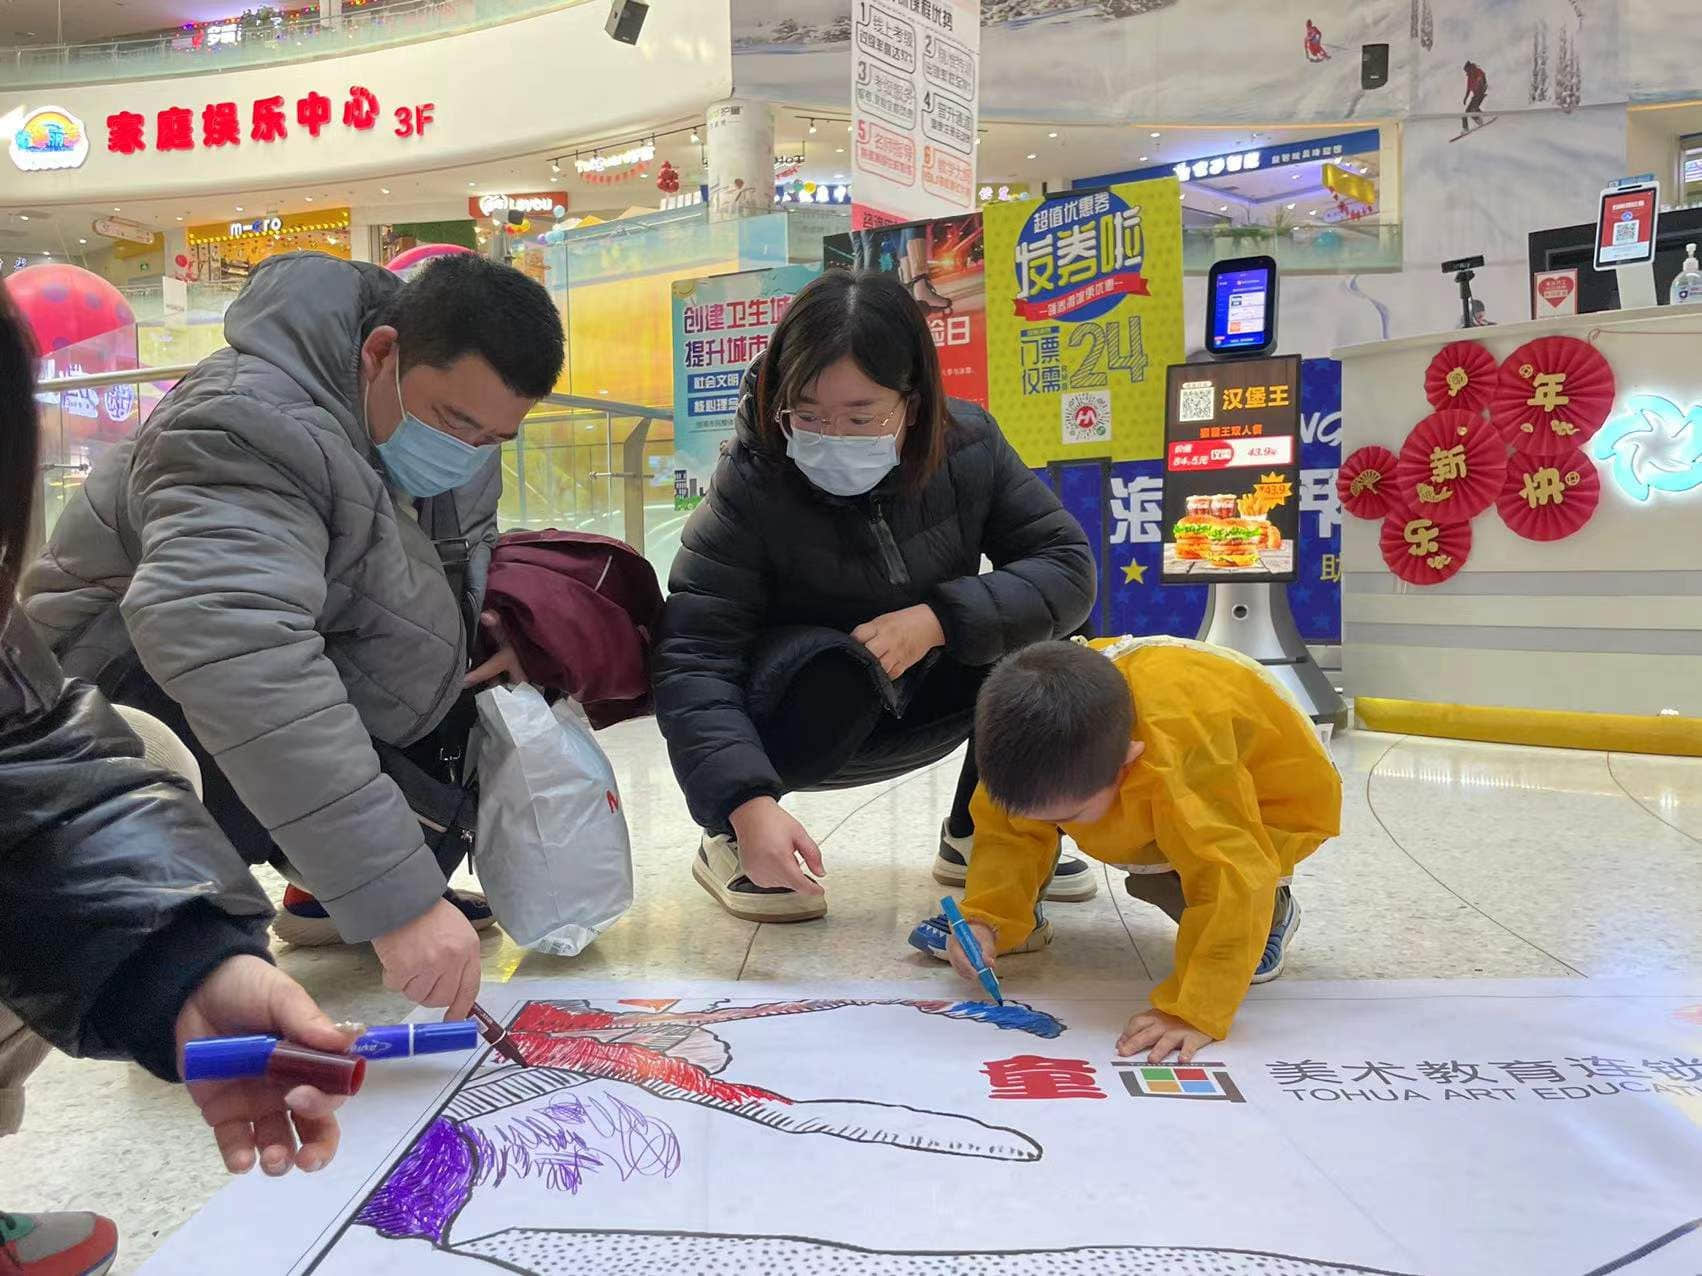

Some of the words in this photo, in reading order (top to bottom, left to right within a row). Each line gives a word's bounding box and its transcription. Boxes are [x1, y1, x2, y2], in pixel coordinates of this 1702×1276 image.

[858, 61, 866, 80] 3
[923, 91, 932, 110] 4
[106, 86, 381, 155] 家庭娱乐中心
[394, 103, 435, 138] 3F
[1034, 191, 1110, 234] 超值优惠券
[684, 295, 793, 334] 创建卫生城
[685, 334, 769, 368] 提升城市
[1020, 336, 1060, 367] 门票
[1067, 315, 1149, 389] 24
[694, 373, 739, 389] 社会文明
[1022, 365, 1061, 396] 仅需
[1527, 373, 1569, 412] 年
[1222, 385, 1289, 411] 汉堡王
[1430, 445, 1468, 484] 新
[1519, 467, 1565, 508] 快
[1404, 519, 1440, 557] 乐
[1265, 1056, 1702, 1085] 美术教育连锁
[1282, 1088, 1431, 1101] TOHUA
[1444, 1088, 1516, 1101] ART
